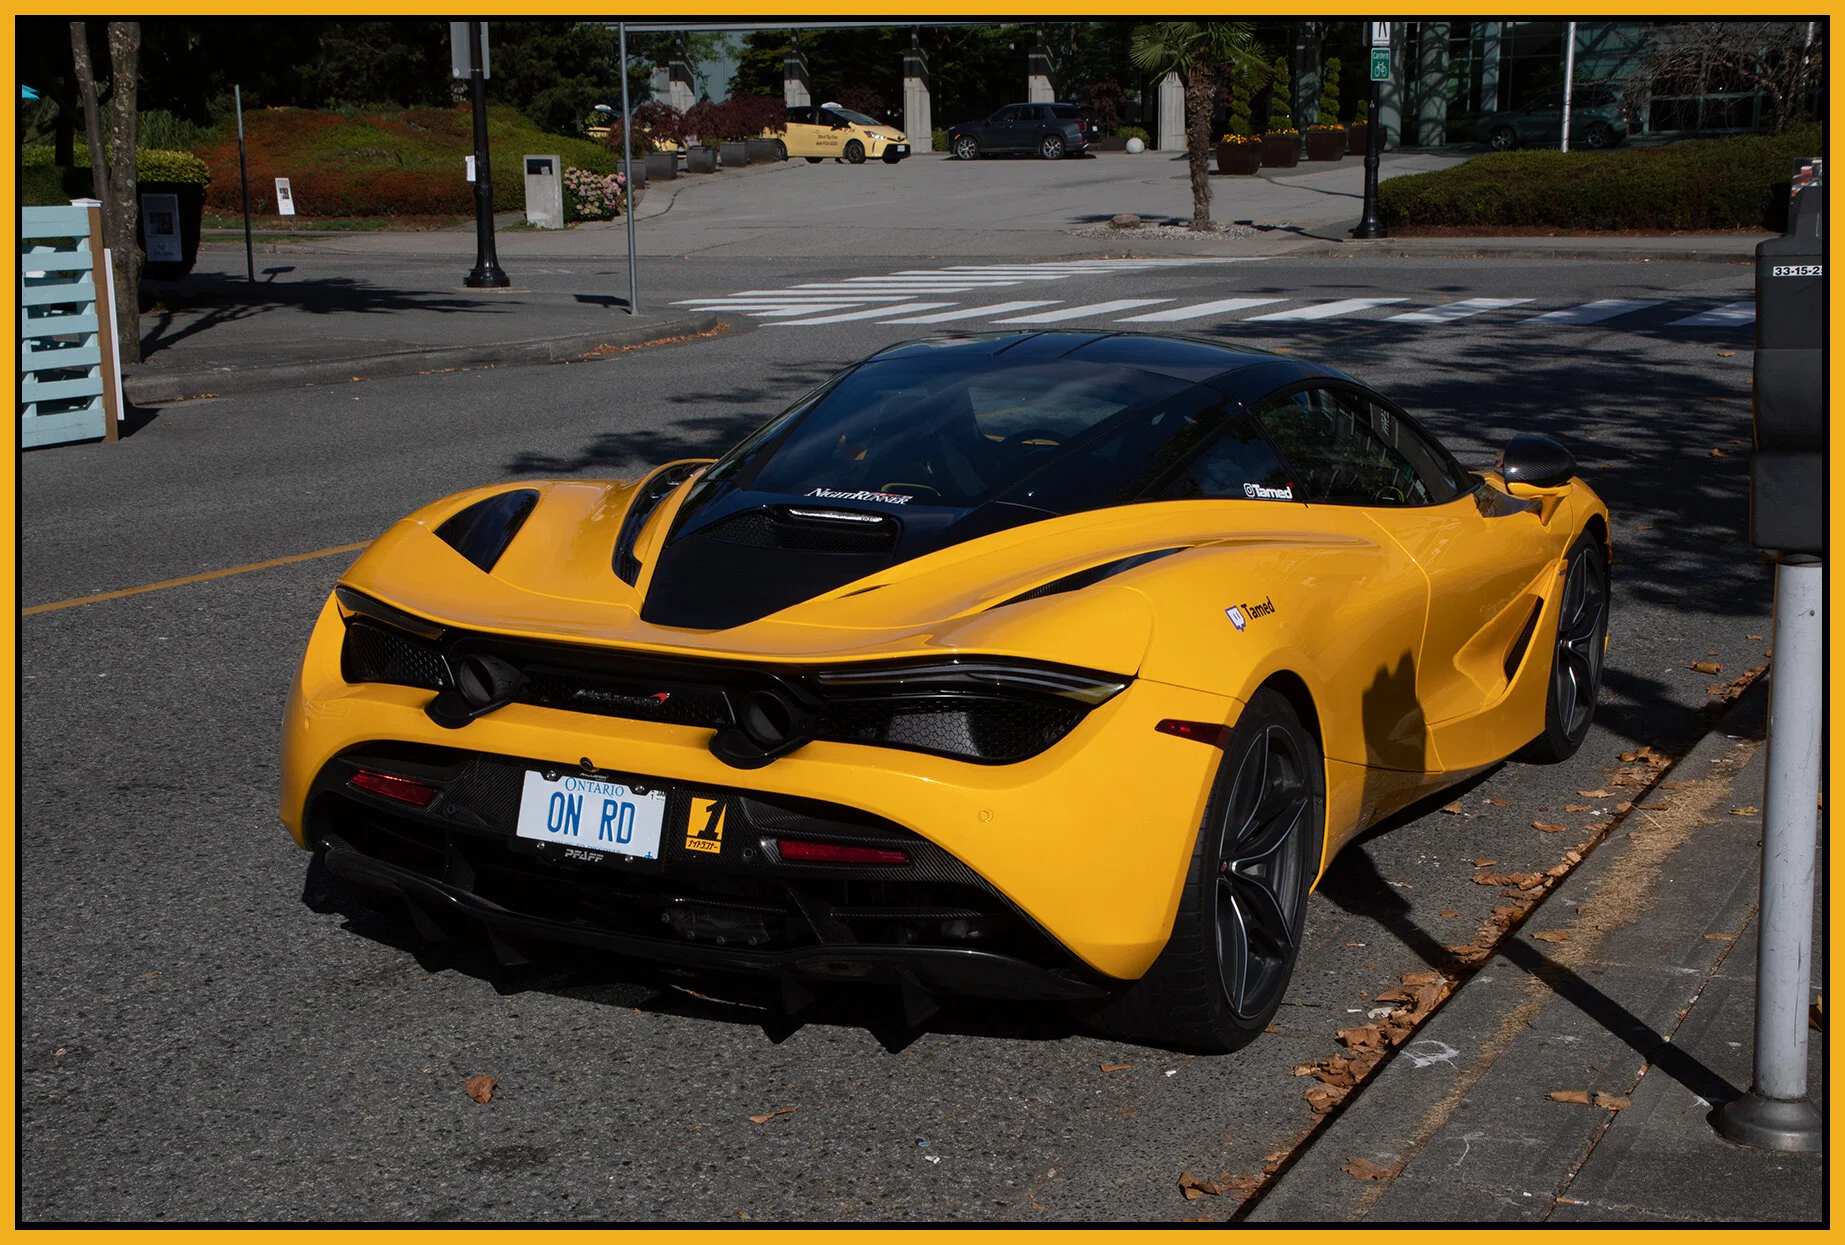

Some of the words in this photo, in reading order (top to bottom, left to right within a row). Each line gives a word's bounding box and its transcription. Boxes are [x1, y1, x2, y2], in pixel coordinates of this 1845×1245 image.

[1774, 266, 1822, 275] 33-15-2
[1252, 484, 1293, 499] Tamed
[1240, 595, 1276, 620] Tamed
[564, 777, 625, 798] ONTARIO
[547, 791, 584, 837] ON
[598, 798, 636, 844] RD
[564, 848, 605, 863] PFAFF
